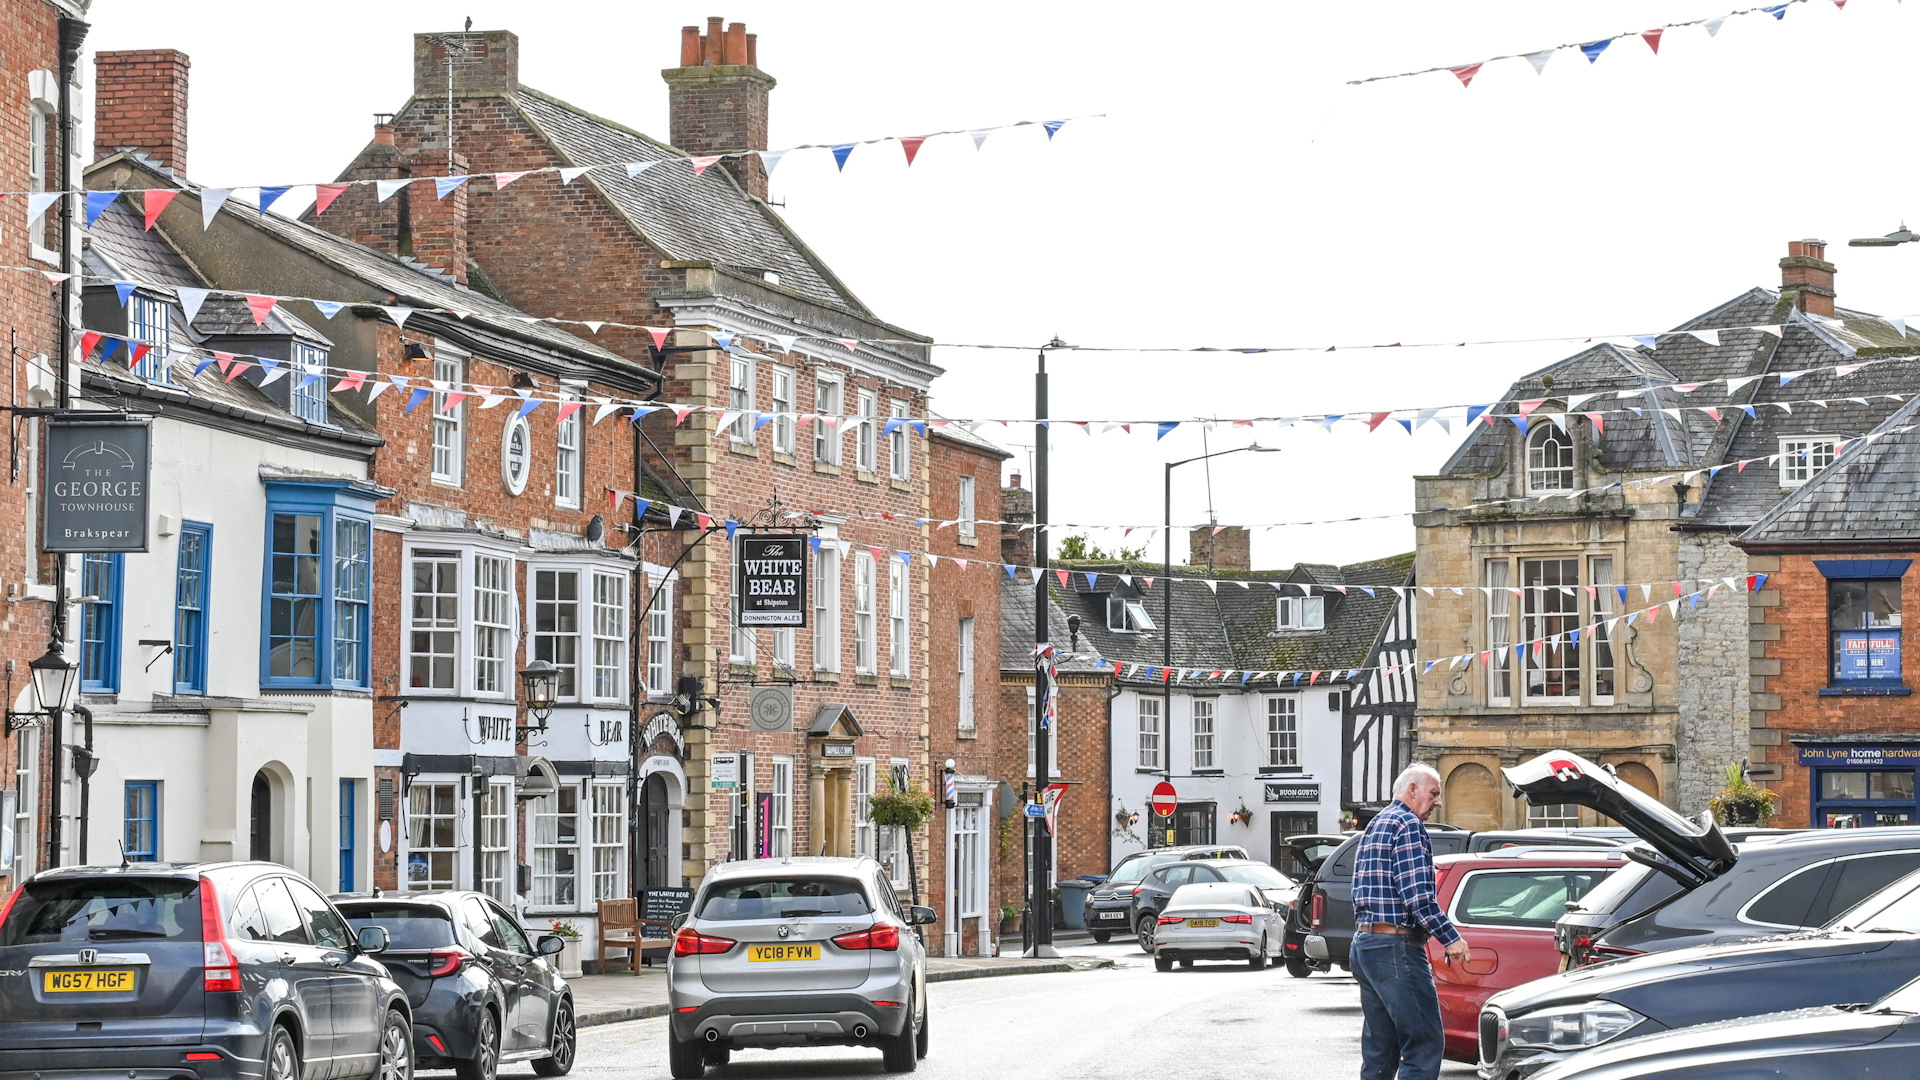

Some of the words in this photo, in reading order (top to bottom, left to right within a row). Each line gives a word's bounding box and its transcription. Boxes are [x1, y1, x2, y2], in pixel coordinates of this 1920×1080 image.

[84, 469, 112, 477] THE
[54, 481, 141, 497] GEORGE
[60, 502, 135, 512] TOWNHOUSE
[64, 528, 130, 540] Brakspear
[762, 544, 784, 557] The
[743, 559, 802, 576] WHITE
[748, 579, 796, 596] BEAR
[763, 598, 788, 608] Shipston
[1856, 658, 1868, 667] SOL
[1870, 658, 1884, 666] HERE
[478, 715, 512, 742] WHITE
[600, 720, 623, 743] BEAR
[1802, 748, 1825, 758] John
[1826, 748, 1849, 760] Lyne
[1851, 748, 1881, 758] home
[756, 947, 784, 959] YC18
[787, 946, 812, 958] FVM
[52, 974, 92, 988] WG57
[96, 973, 127, 987] HGF
